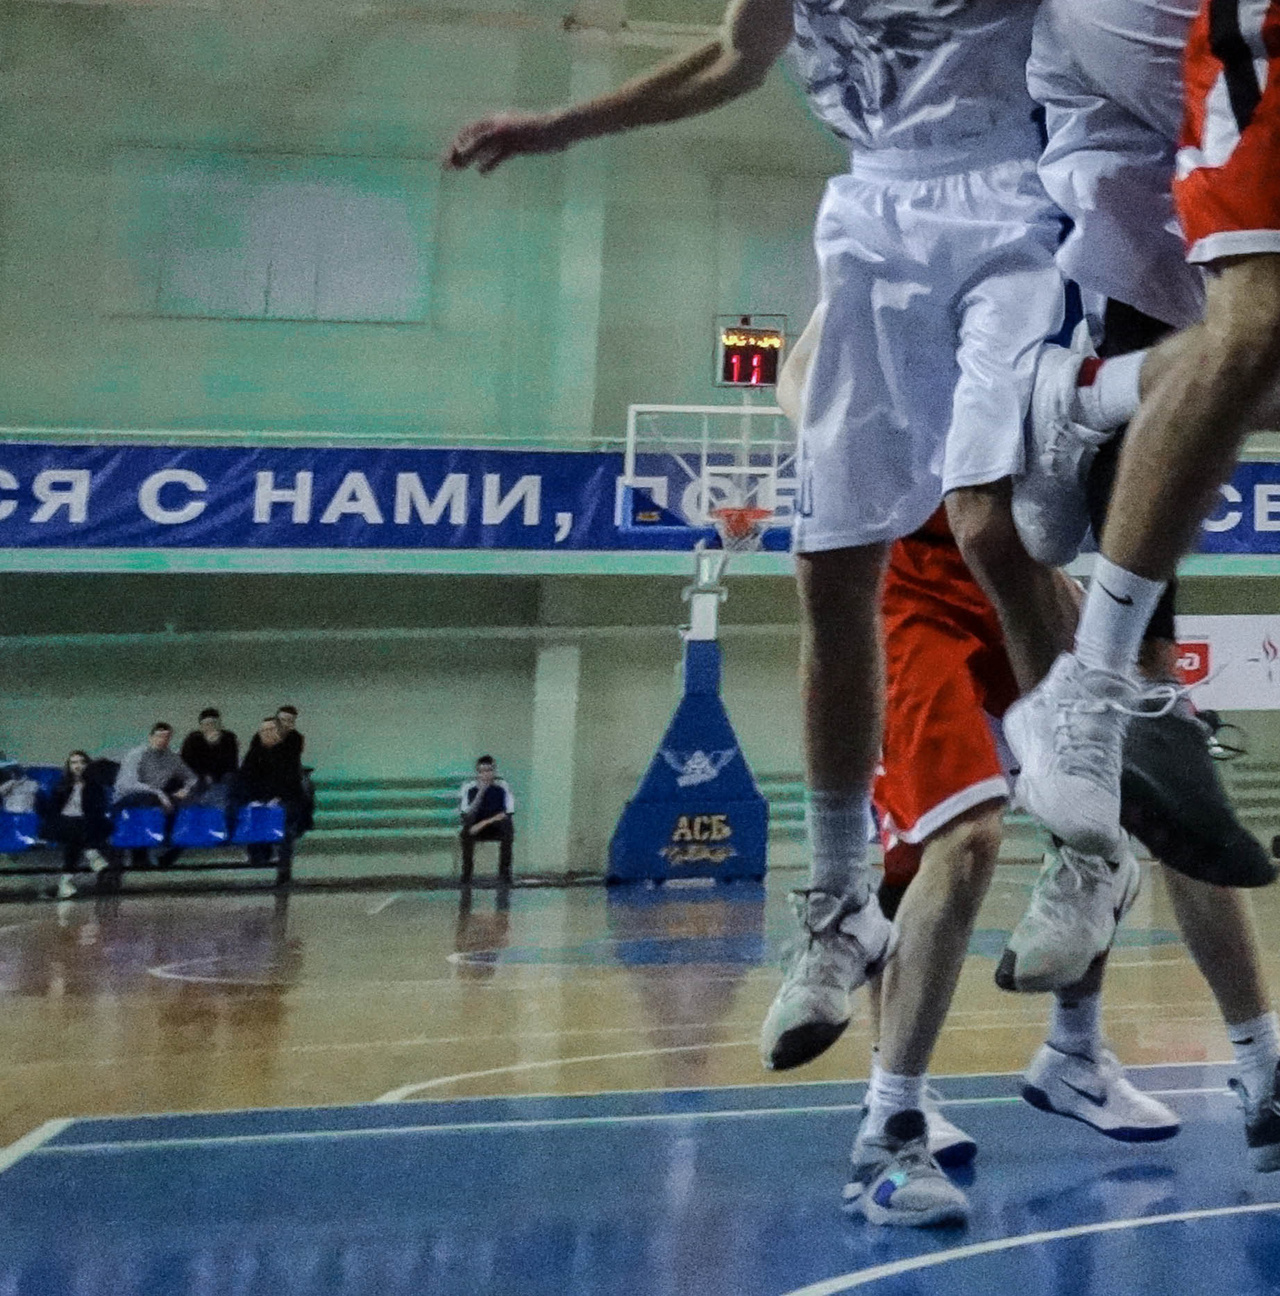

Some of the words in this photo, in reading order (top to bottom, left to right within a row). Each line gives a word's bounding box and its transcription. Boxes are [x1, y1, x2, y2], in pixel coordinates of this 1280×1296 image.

[0, 467, 92, 524] Я
[137, 467, 209, 525] С
[252, 470, 574, 544] НАМИ,
[671, 814, 733, 843] АСБ
